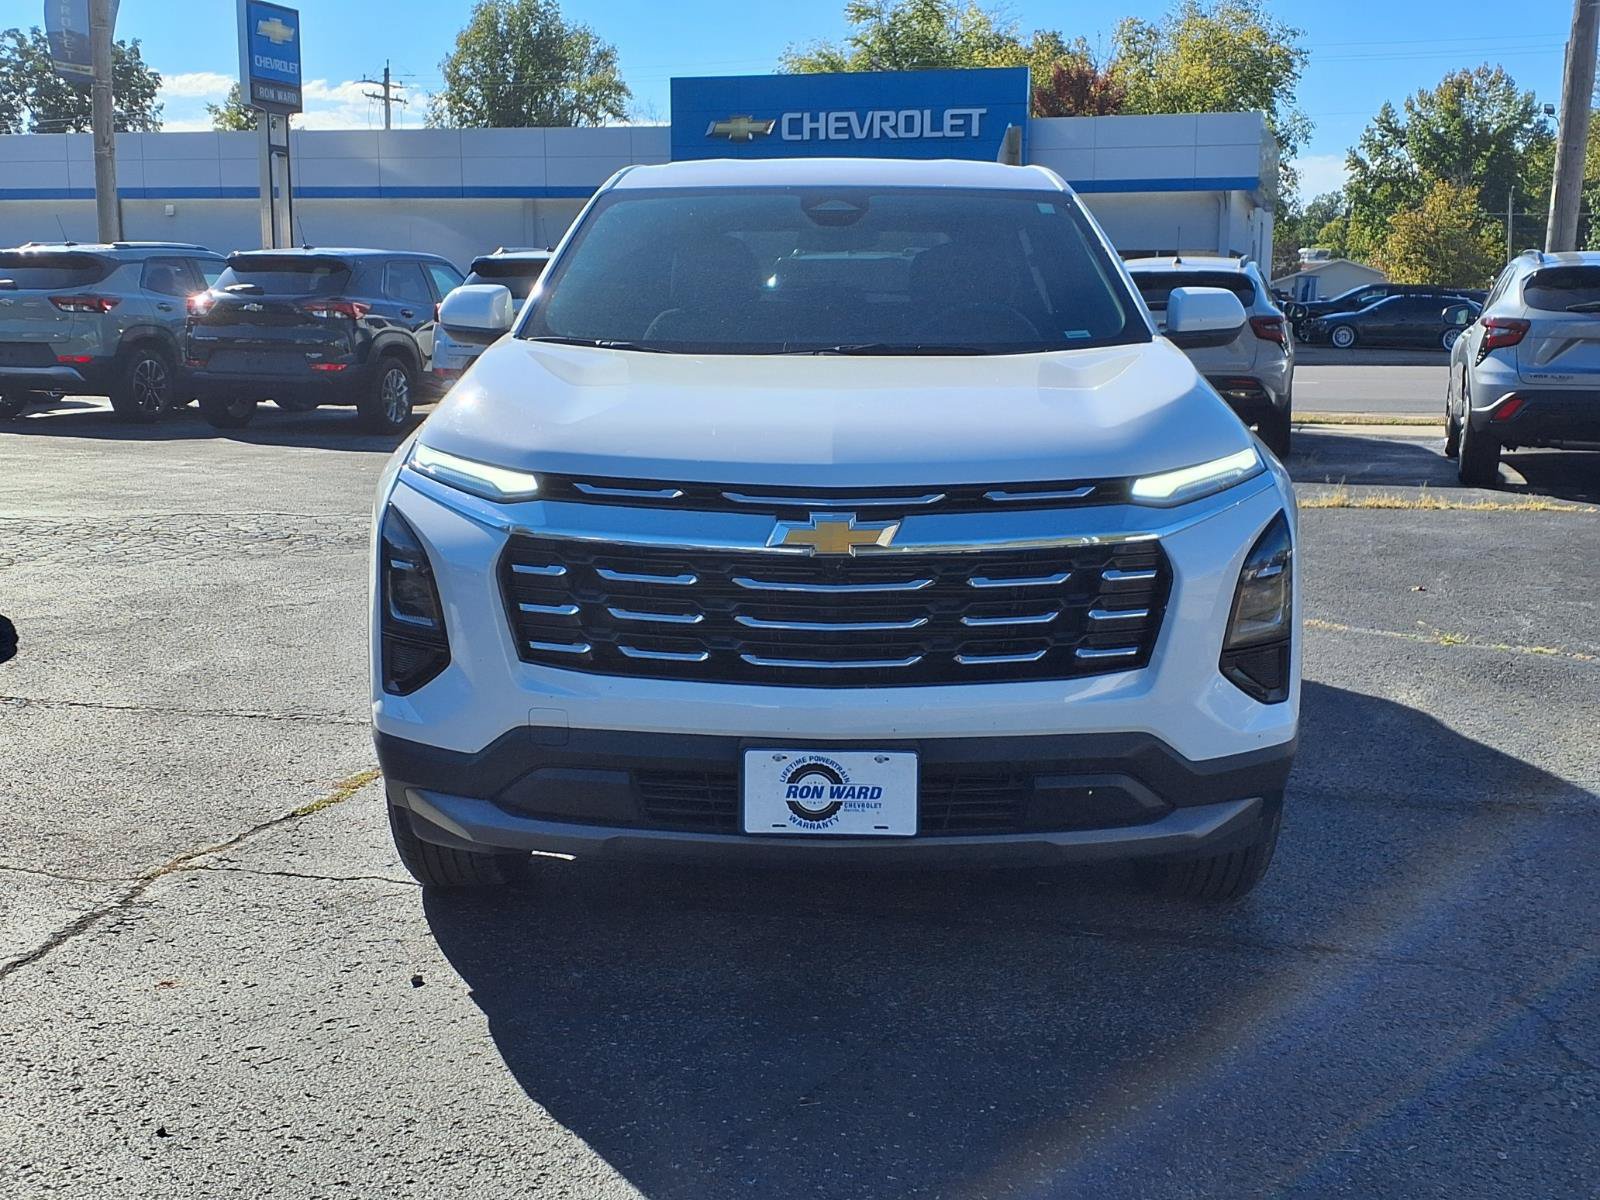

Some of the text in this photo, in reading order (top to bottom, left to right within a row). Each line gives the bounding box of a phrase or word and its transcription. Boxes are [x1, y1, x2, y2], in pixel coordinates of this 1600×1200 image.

[255, 54, 298, 74] CHEVROLET
[259, 86, 297, 104] RON WARD
[781, 108, 987, 141] CHEVROLET
[780, 755, 850, 782] LIFETIME POWERTRAIN
[785, 785, 883, 800] RON WARD
[789, 815, 840, 830] WARRANTY
